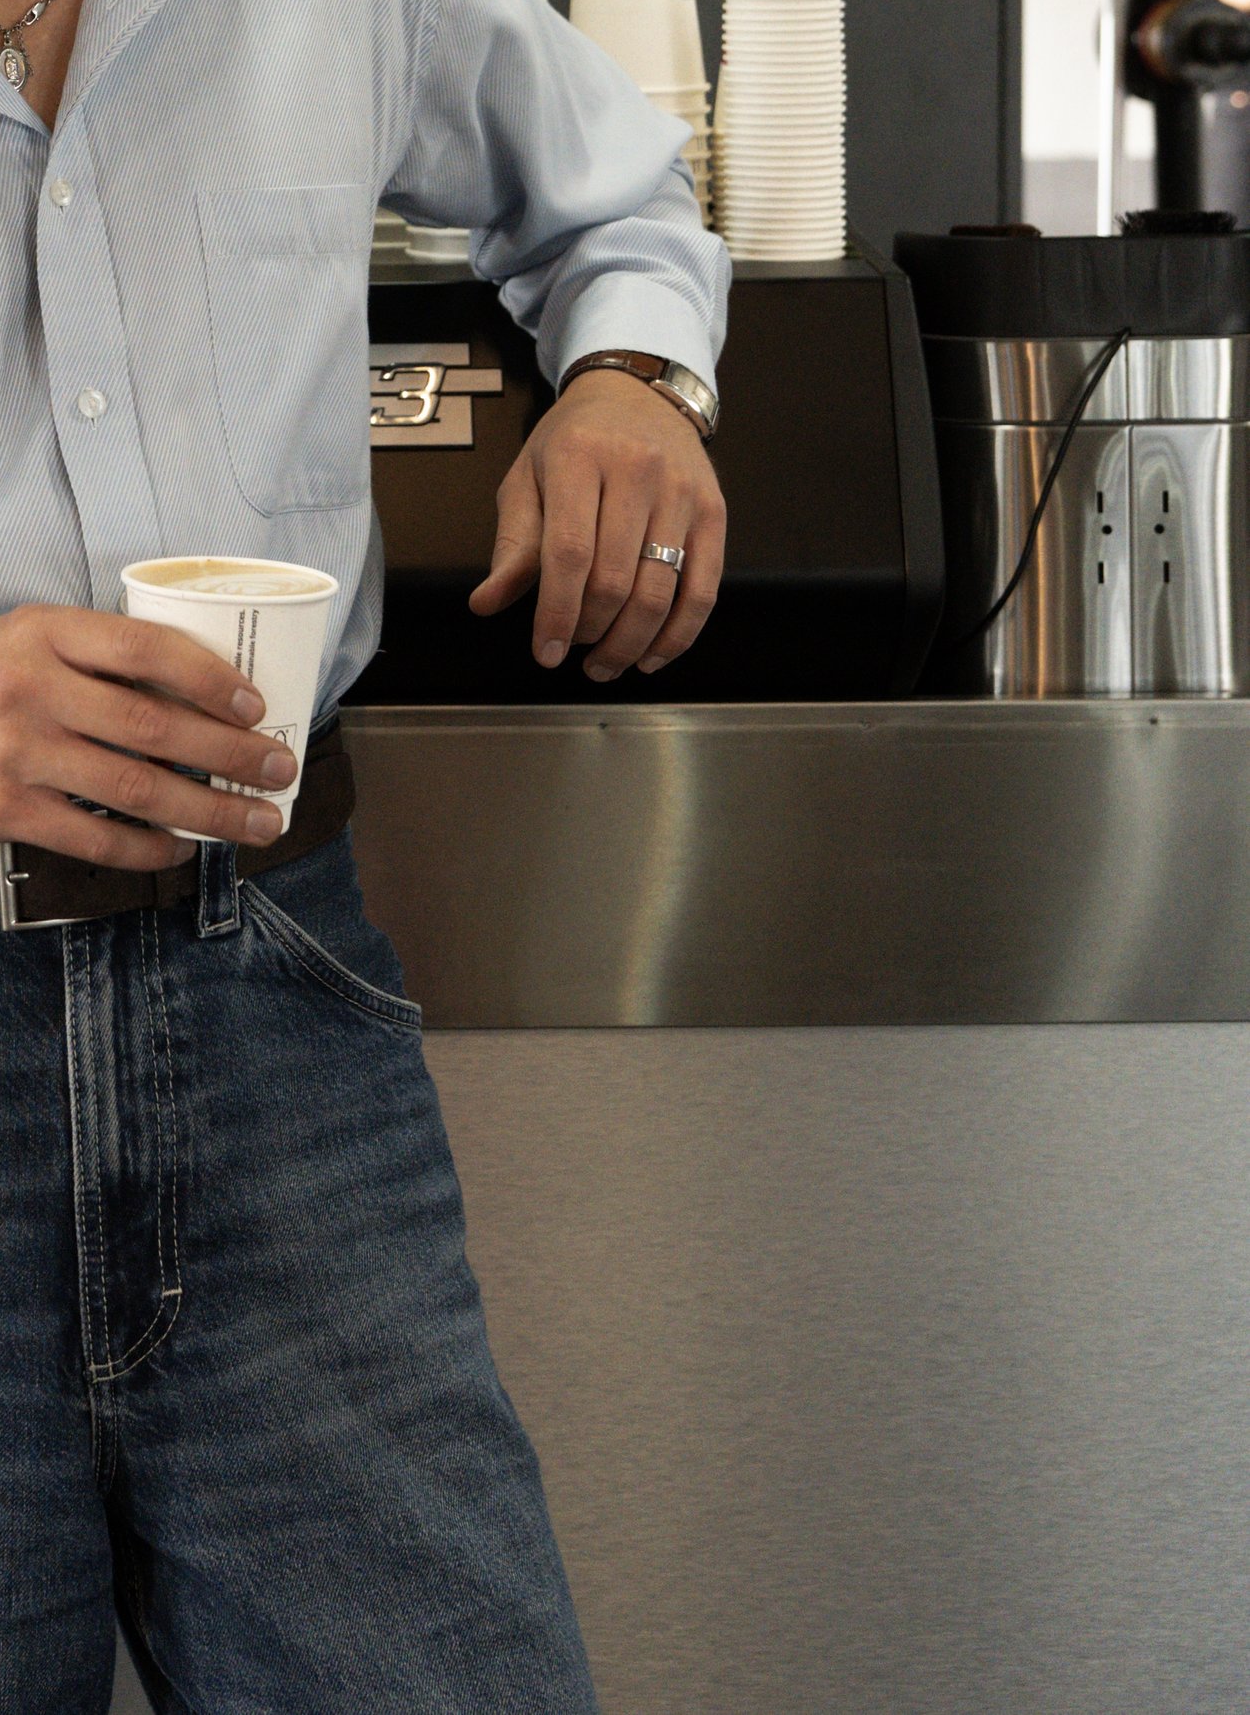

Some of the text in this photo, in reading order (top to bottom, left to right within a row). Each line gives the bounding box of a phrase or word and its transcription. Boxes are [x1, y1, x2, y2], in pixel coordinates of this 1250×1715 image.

[233, 609, 246, 675] able resources.
[249, 609, 261, 639] forestry
